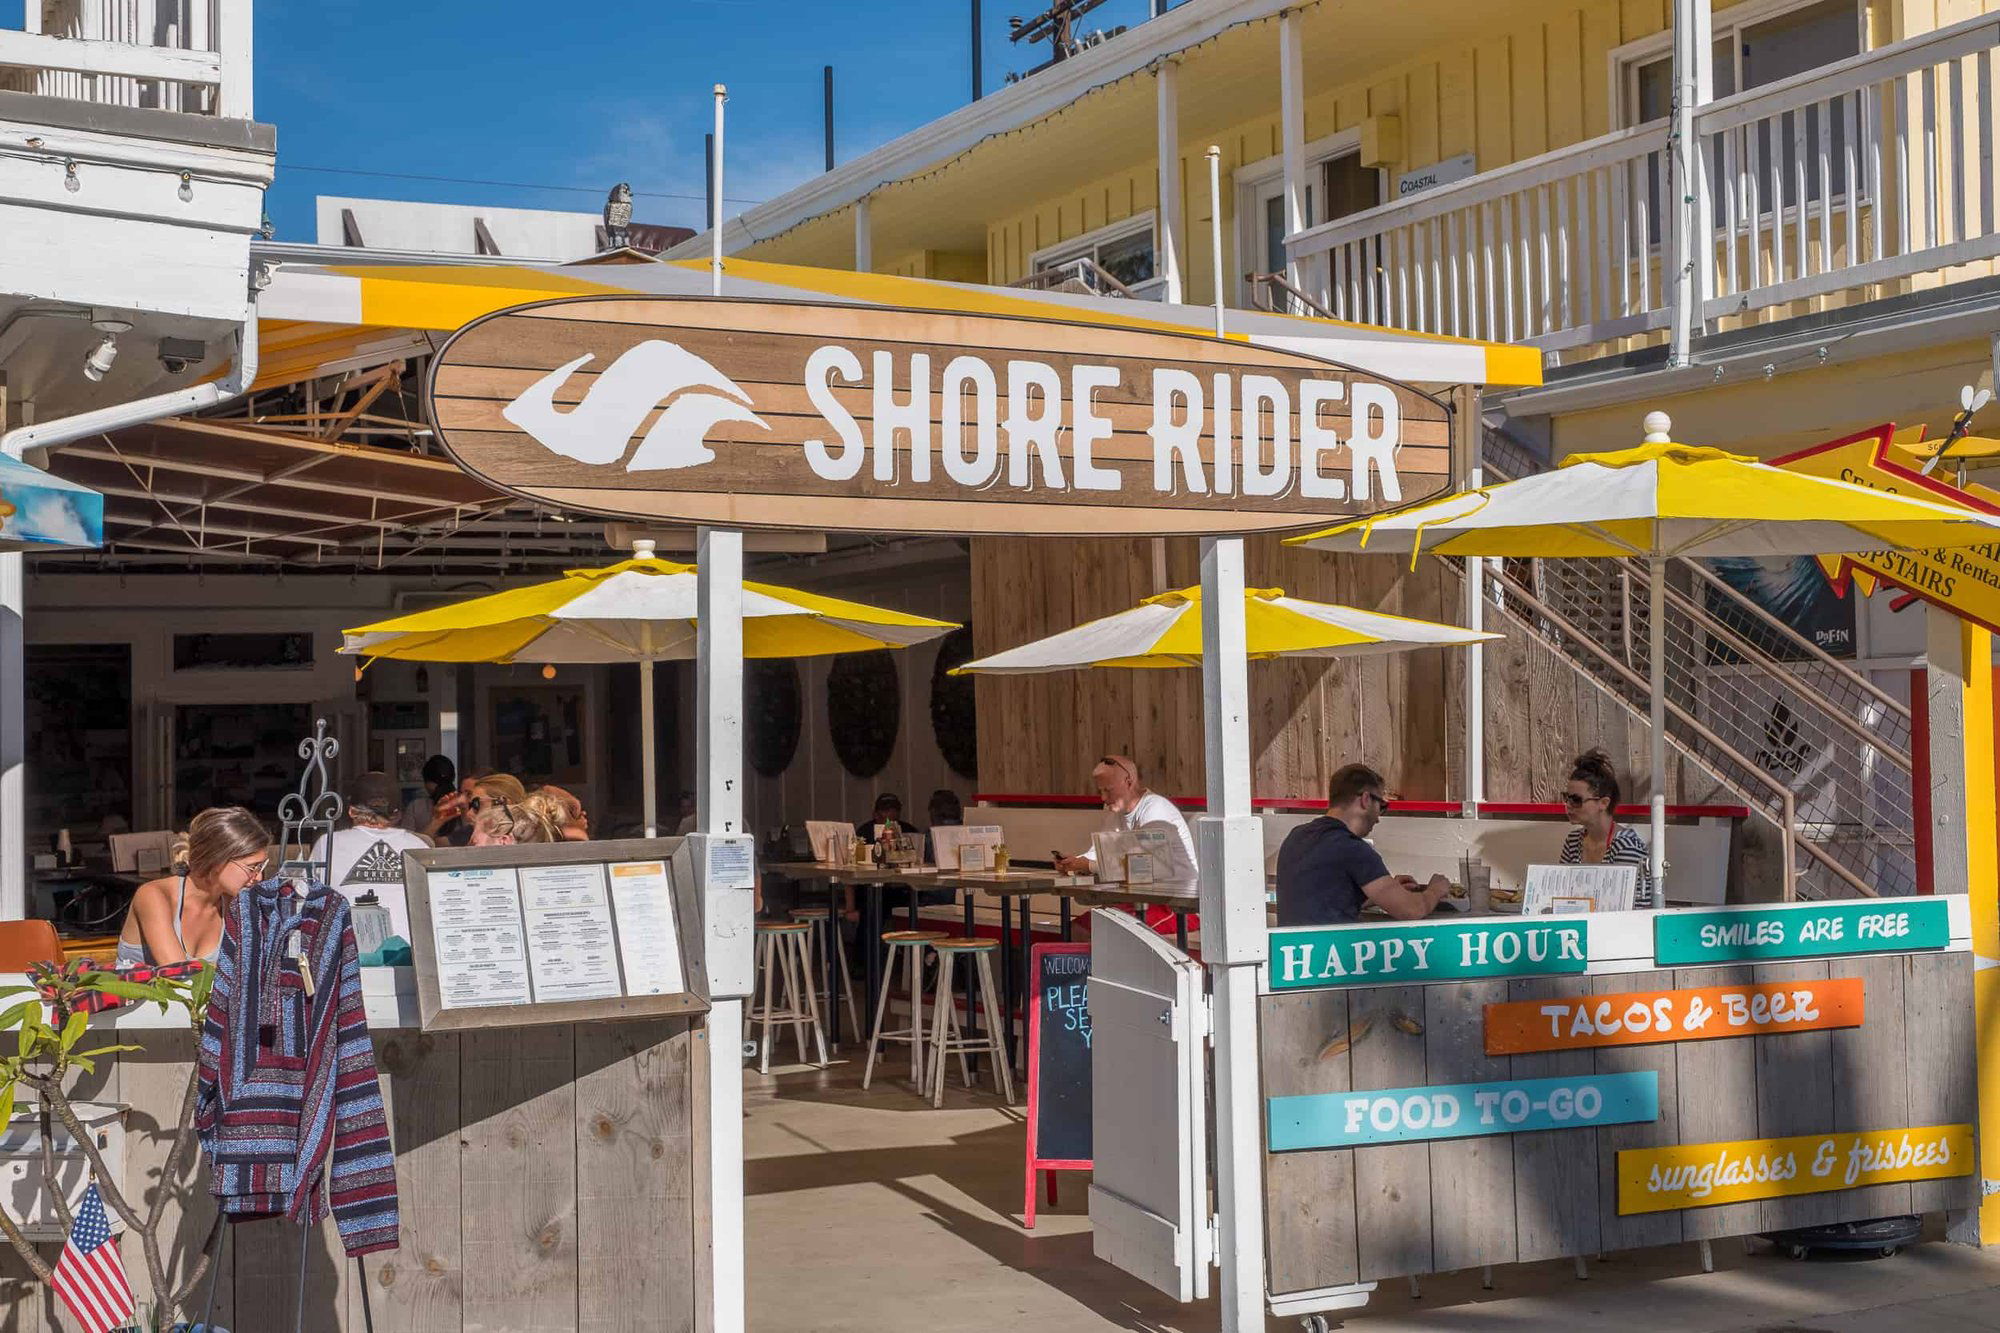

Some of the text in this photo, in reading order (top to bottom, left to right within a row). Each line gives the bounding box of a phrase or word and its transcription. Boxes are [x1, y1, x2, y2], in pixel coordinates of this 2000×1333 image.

[1400, 174, 1437, 193] COASTAL
[803, 345, 1404, 502] SHORE RIDER
[1950, 552, 2000, 590] Renta
[1755, 744, 1811, 773] reef
[1701, 912, 1910, 948] SMILES ARE FREE
[1043, 957, 1091, 975] WELCOM
[1280, 928, 1586, 981] HAPPY HOUR
[1064, 1006, 1092, 1030] SE
[1541, 997, 1672, 1038] TACOS
[1683, 996, 1714, 1032] &
[1344, 1085, 1603, 1133] FOOD TO-GO
[1647, 1134, 1951, 1197] sunglasses & frisbees
